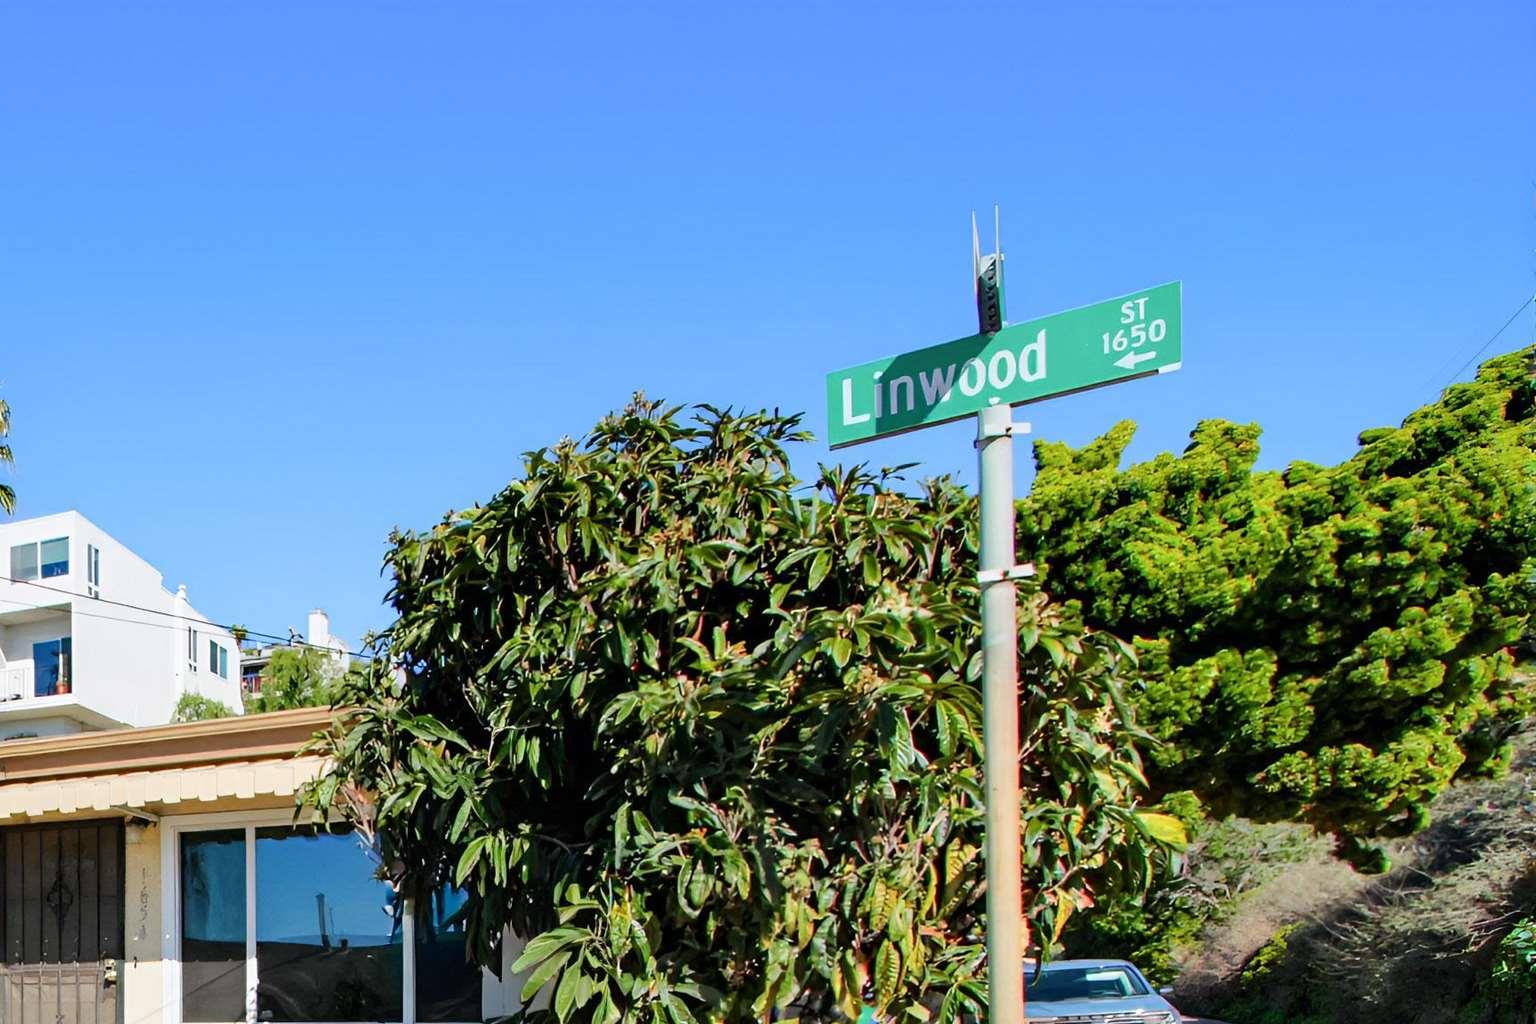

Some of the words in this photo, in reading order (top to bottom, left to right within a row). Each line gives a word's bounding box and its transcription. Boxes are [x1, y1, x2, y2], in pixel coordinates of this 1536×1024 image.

[1120, 297, 1150, 325] ST
[1102, 318, 1167, 355] 1650
[841, 328, 1047, 427] Linwood
